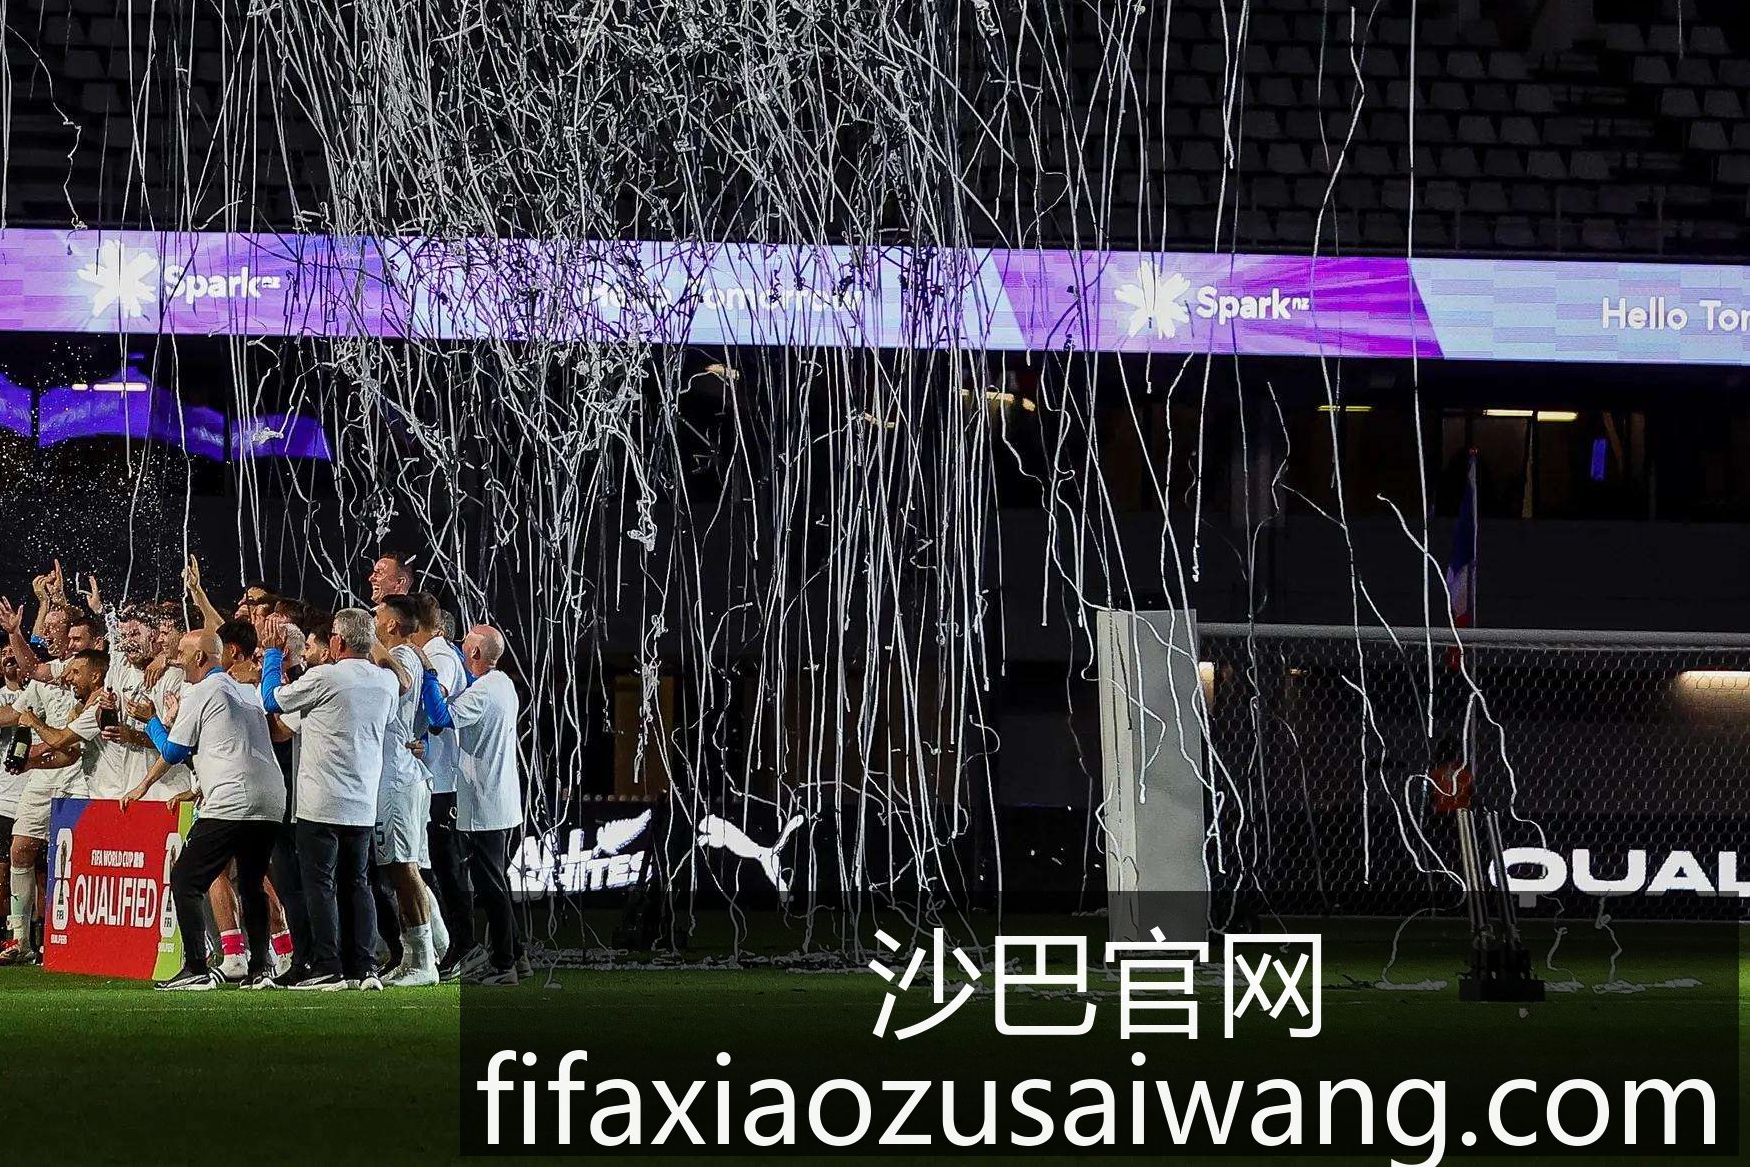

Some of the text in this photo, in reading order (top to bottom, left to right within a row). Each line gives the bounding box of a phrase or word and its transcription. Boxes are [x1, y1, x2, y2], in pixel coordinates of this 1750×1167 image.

[164, 264, 261, 304] Spark
[1196, 285, 1291, 325] Spark
[1601, 296, 1688, 331] Hello
[1488, 846, 1750, 909] QUAL
[73, 874, 157, 928] QUALIFIED
